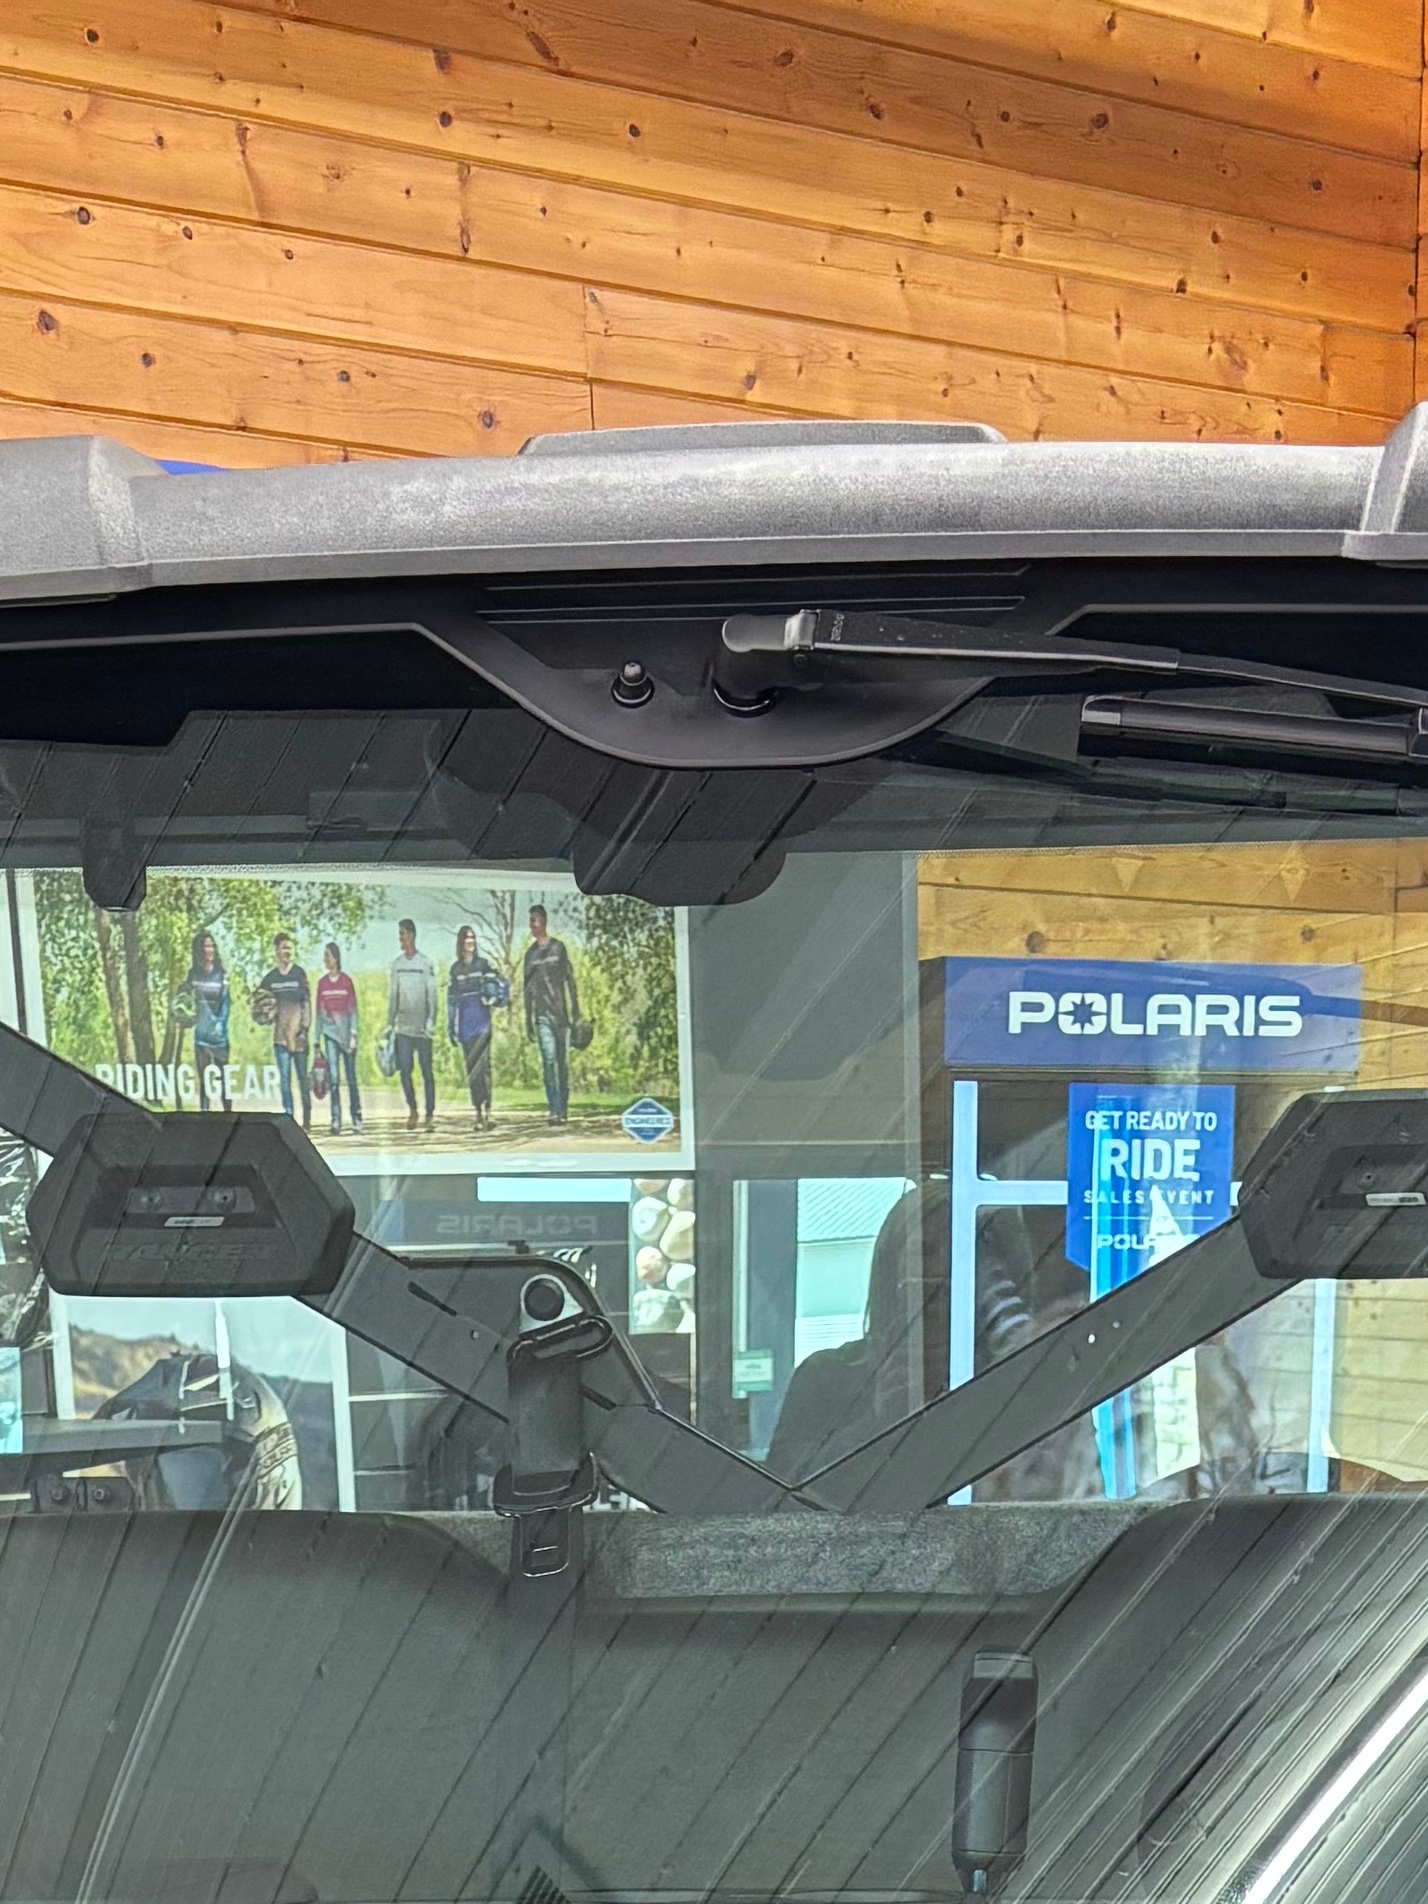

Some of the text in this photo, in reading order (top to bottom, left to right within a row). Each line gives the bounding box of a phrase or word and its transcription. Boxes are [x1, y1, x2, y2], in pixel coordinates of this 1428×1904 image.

[1008, 991, 1303, 1037] POLARIS
[94, 1063, 281, 1101] RIDING GEAR
[1085, 1110, 1218, 1131] GET READY TO
[1100, 1138, 1201, 1182] RIDE
[1084, 1189, 1145, 1205] SALES
